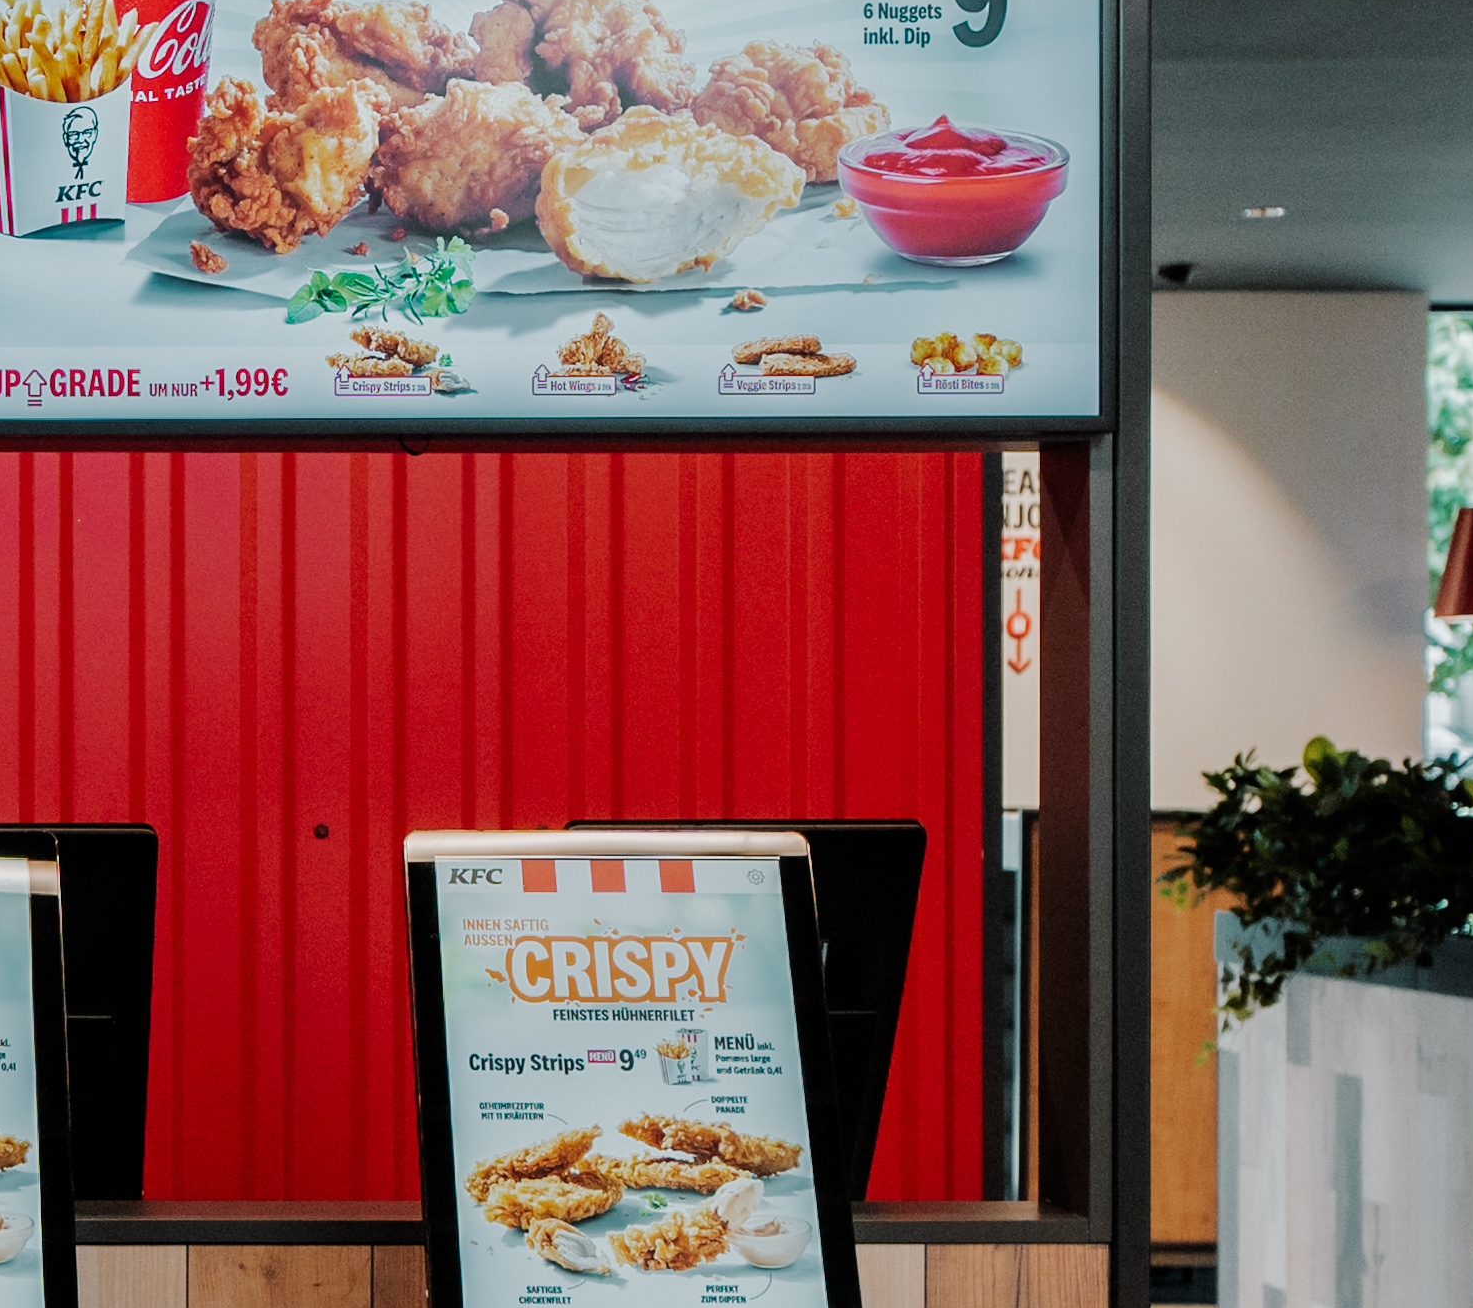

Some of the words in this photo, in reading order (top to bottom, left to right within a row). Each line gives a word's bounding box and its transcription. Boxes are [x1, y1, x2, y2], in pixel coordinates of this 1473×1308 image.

[863, 2, 874, 20] 6
[878, 2, 943, 24] Nuggets
[863, 26, 900, 45] inkl.
[904, 26, 931, 49] Dip
[55, 181, 102, 203] KFC
[200, 366, 289, 400] +1,99€
[352, 380, 380, 395] Crispy
[383, 380, 411, 395] Strips
[550, 380, 567, 391] Hot
[569, 380, 596, 395] Wings
[736, 379, 766, 395] Veggie
[768, 379, 796, 394] Strips
[935, 379, 959, 391] Rösti
[961, 379, 984, 391] Bites
[448, 867, 503, 884] KFC
[507, 937, 735, 1003] CRISPY
[552, 1008, 610, 1022] FEINSTES
[611, 1006, 695, 1022] HÜHNERFILET
[714, 1034, 755, 1051] MENÜ
[468, 1052, 526, 1075] Crispy
[530, 1053, 585, 1075] Strips
